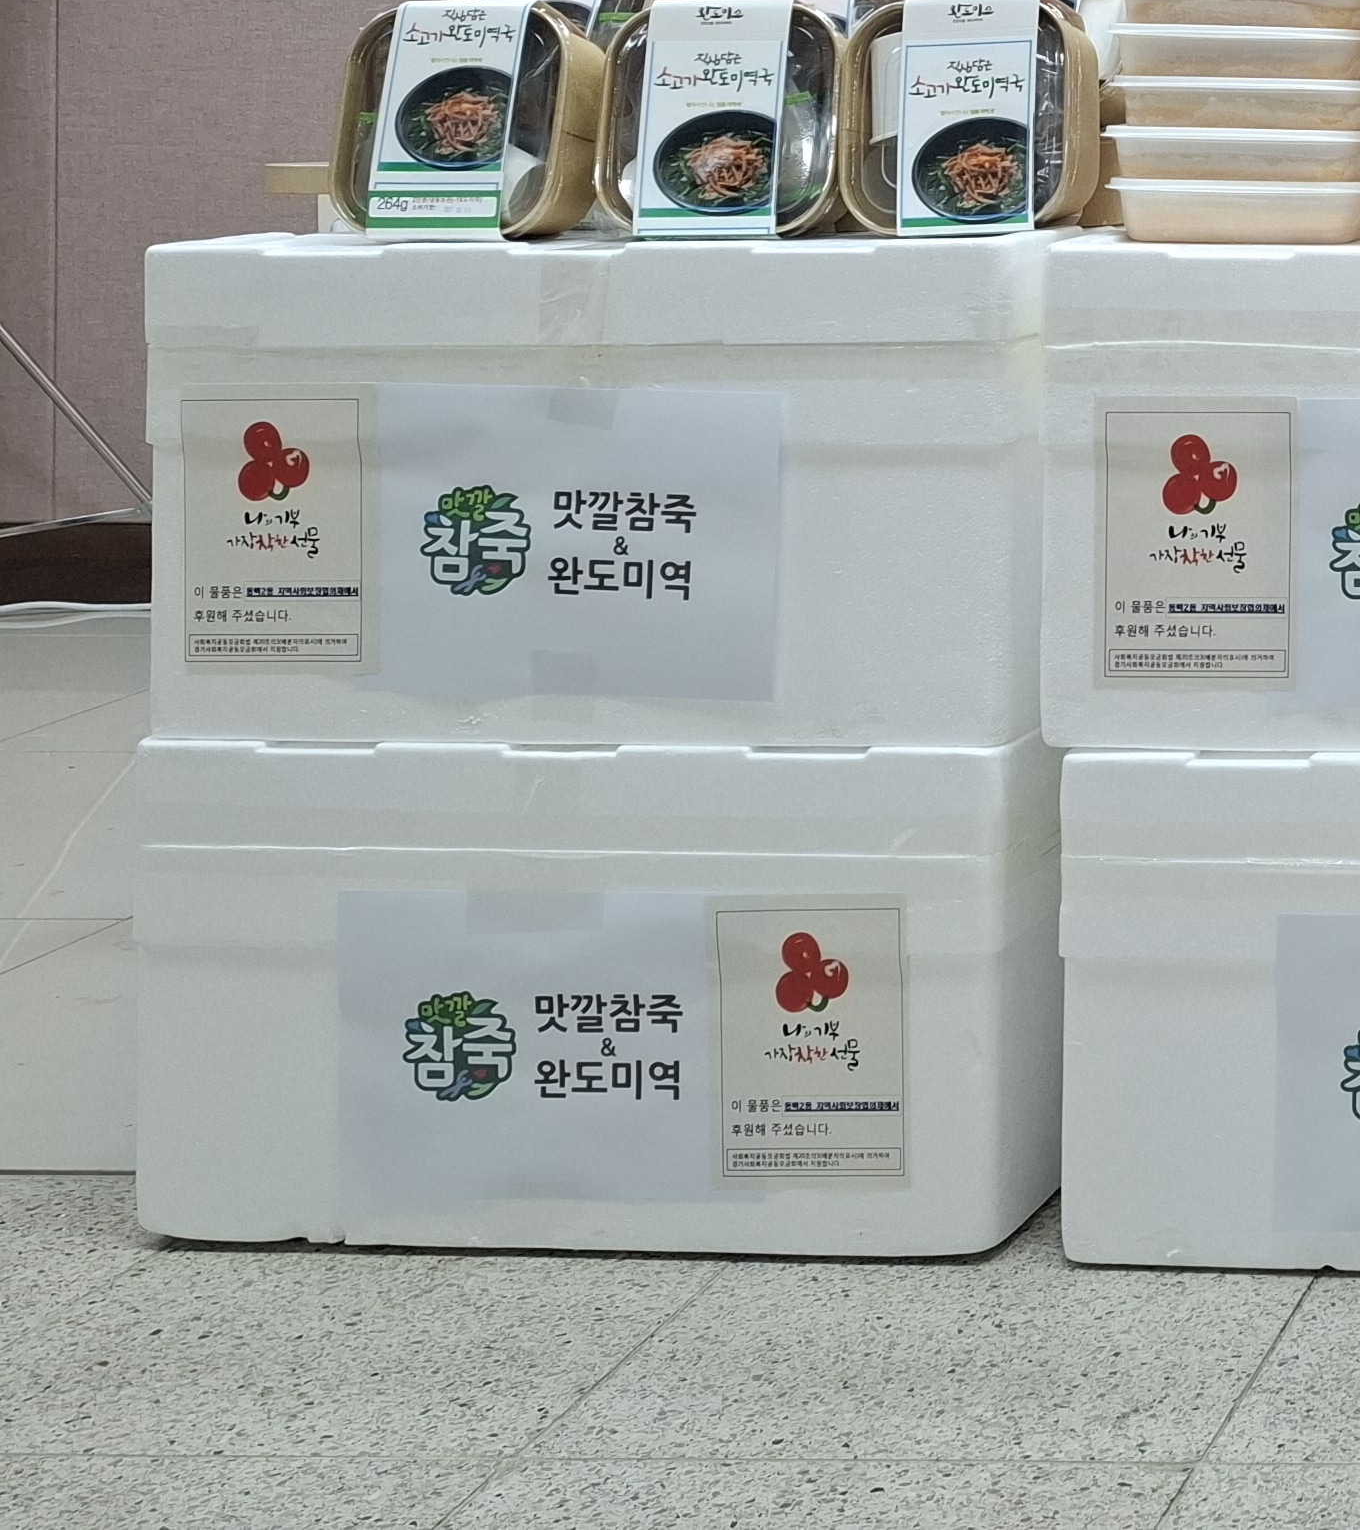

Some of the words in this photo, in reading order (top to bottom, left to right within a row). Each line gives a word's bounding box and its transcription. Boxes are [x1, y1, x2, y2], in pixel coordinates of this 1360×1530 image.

[376, 197, 409, 212] 264g
[440, 490, 494, 520] 맛깔
[553, 489, 697, 534] 맛깔참죽
[422, 513, 529, 584] 참죽
[613, 536, 629, 556] &
[547, 557, 692, 601] 완도미역
[194, 609, 227, 623] 후원해
[231, 608, 292, 622] 주셨습니다.
[1115, 624, 1149, 637] 후원해
[1153, 624, 1216, 637] 주셨습니다.
[419, 992, 472, 1026] 맛깔
[534, 993, 684, 1035] 맛깔참죽
[404, 1017, 514, 1088] 참죽
[600, 1037, 617, 1058] &
[534, 1059, 681, 1100] 완도미역
[732, 1123, 766, 1137] 후원해
[770, 1122, 832, 1136] 주셨습니다.
